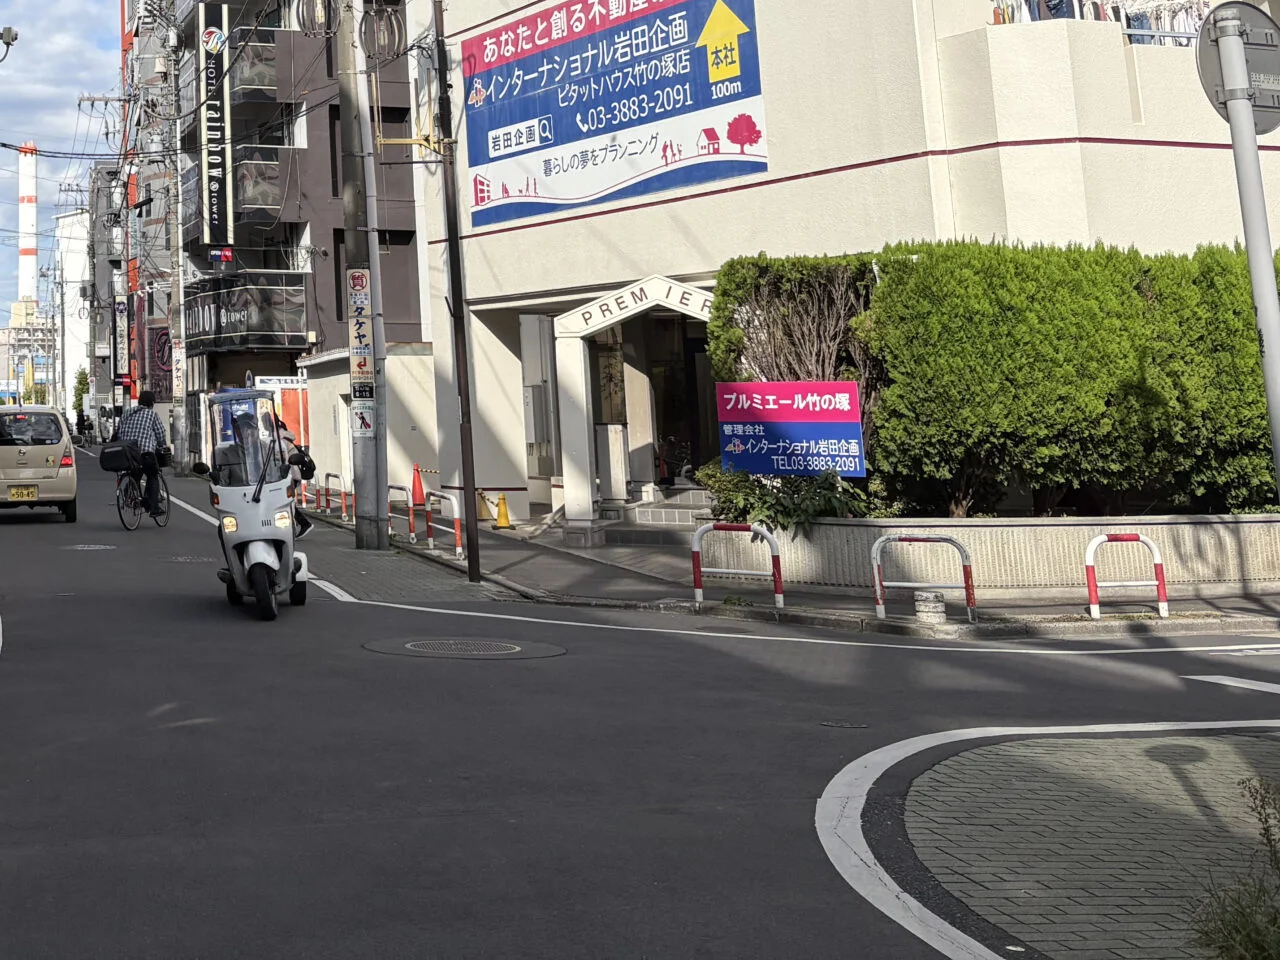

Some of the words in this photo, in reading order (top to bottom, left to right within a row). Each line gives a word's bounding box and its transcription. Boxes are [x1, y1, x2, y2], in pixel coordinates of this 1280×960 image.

[486, 11, 689, 103] インターナショナル岩田企画
[710, 42, 737, 69] 本社
[558, 49, 691, 107] ピタットハウス竹の塚店
[711, 81, 742, 100] 100m
[588, 83, 693, 131] 03-3883-2091
[206, 100, 224, 178] rainbow
[491, 124, 536, 152] 岩田企画
[542, 132, 660, 177] 暮らしの夢をプランニング
[211, 191, 219, 225] tower
[353, 306, 367, 345] タケヤ
[723, 424, 765, 436] 管理会社
[745, 439, 859, 456] インターナショナル岩田企画
[771, 456, 860, 472] TEL03-3883-2091
